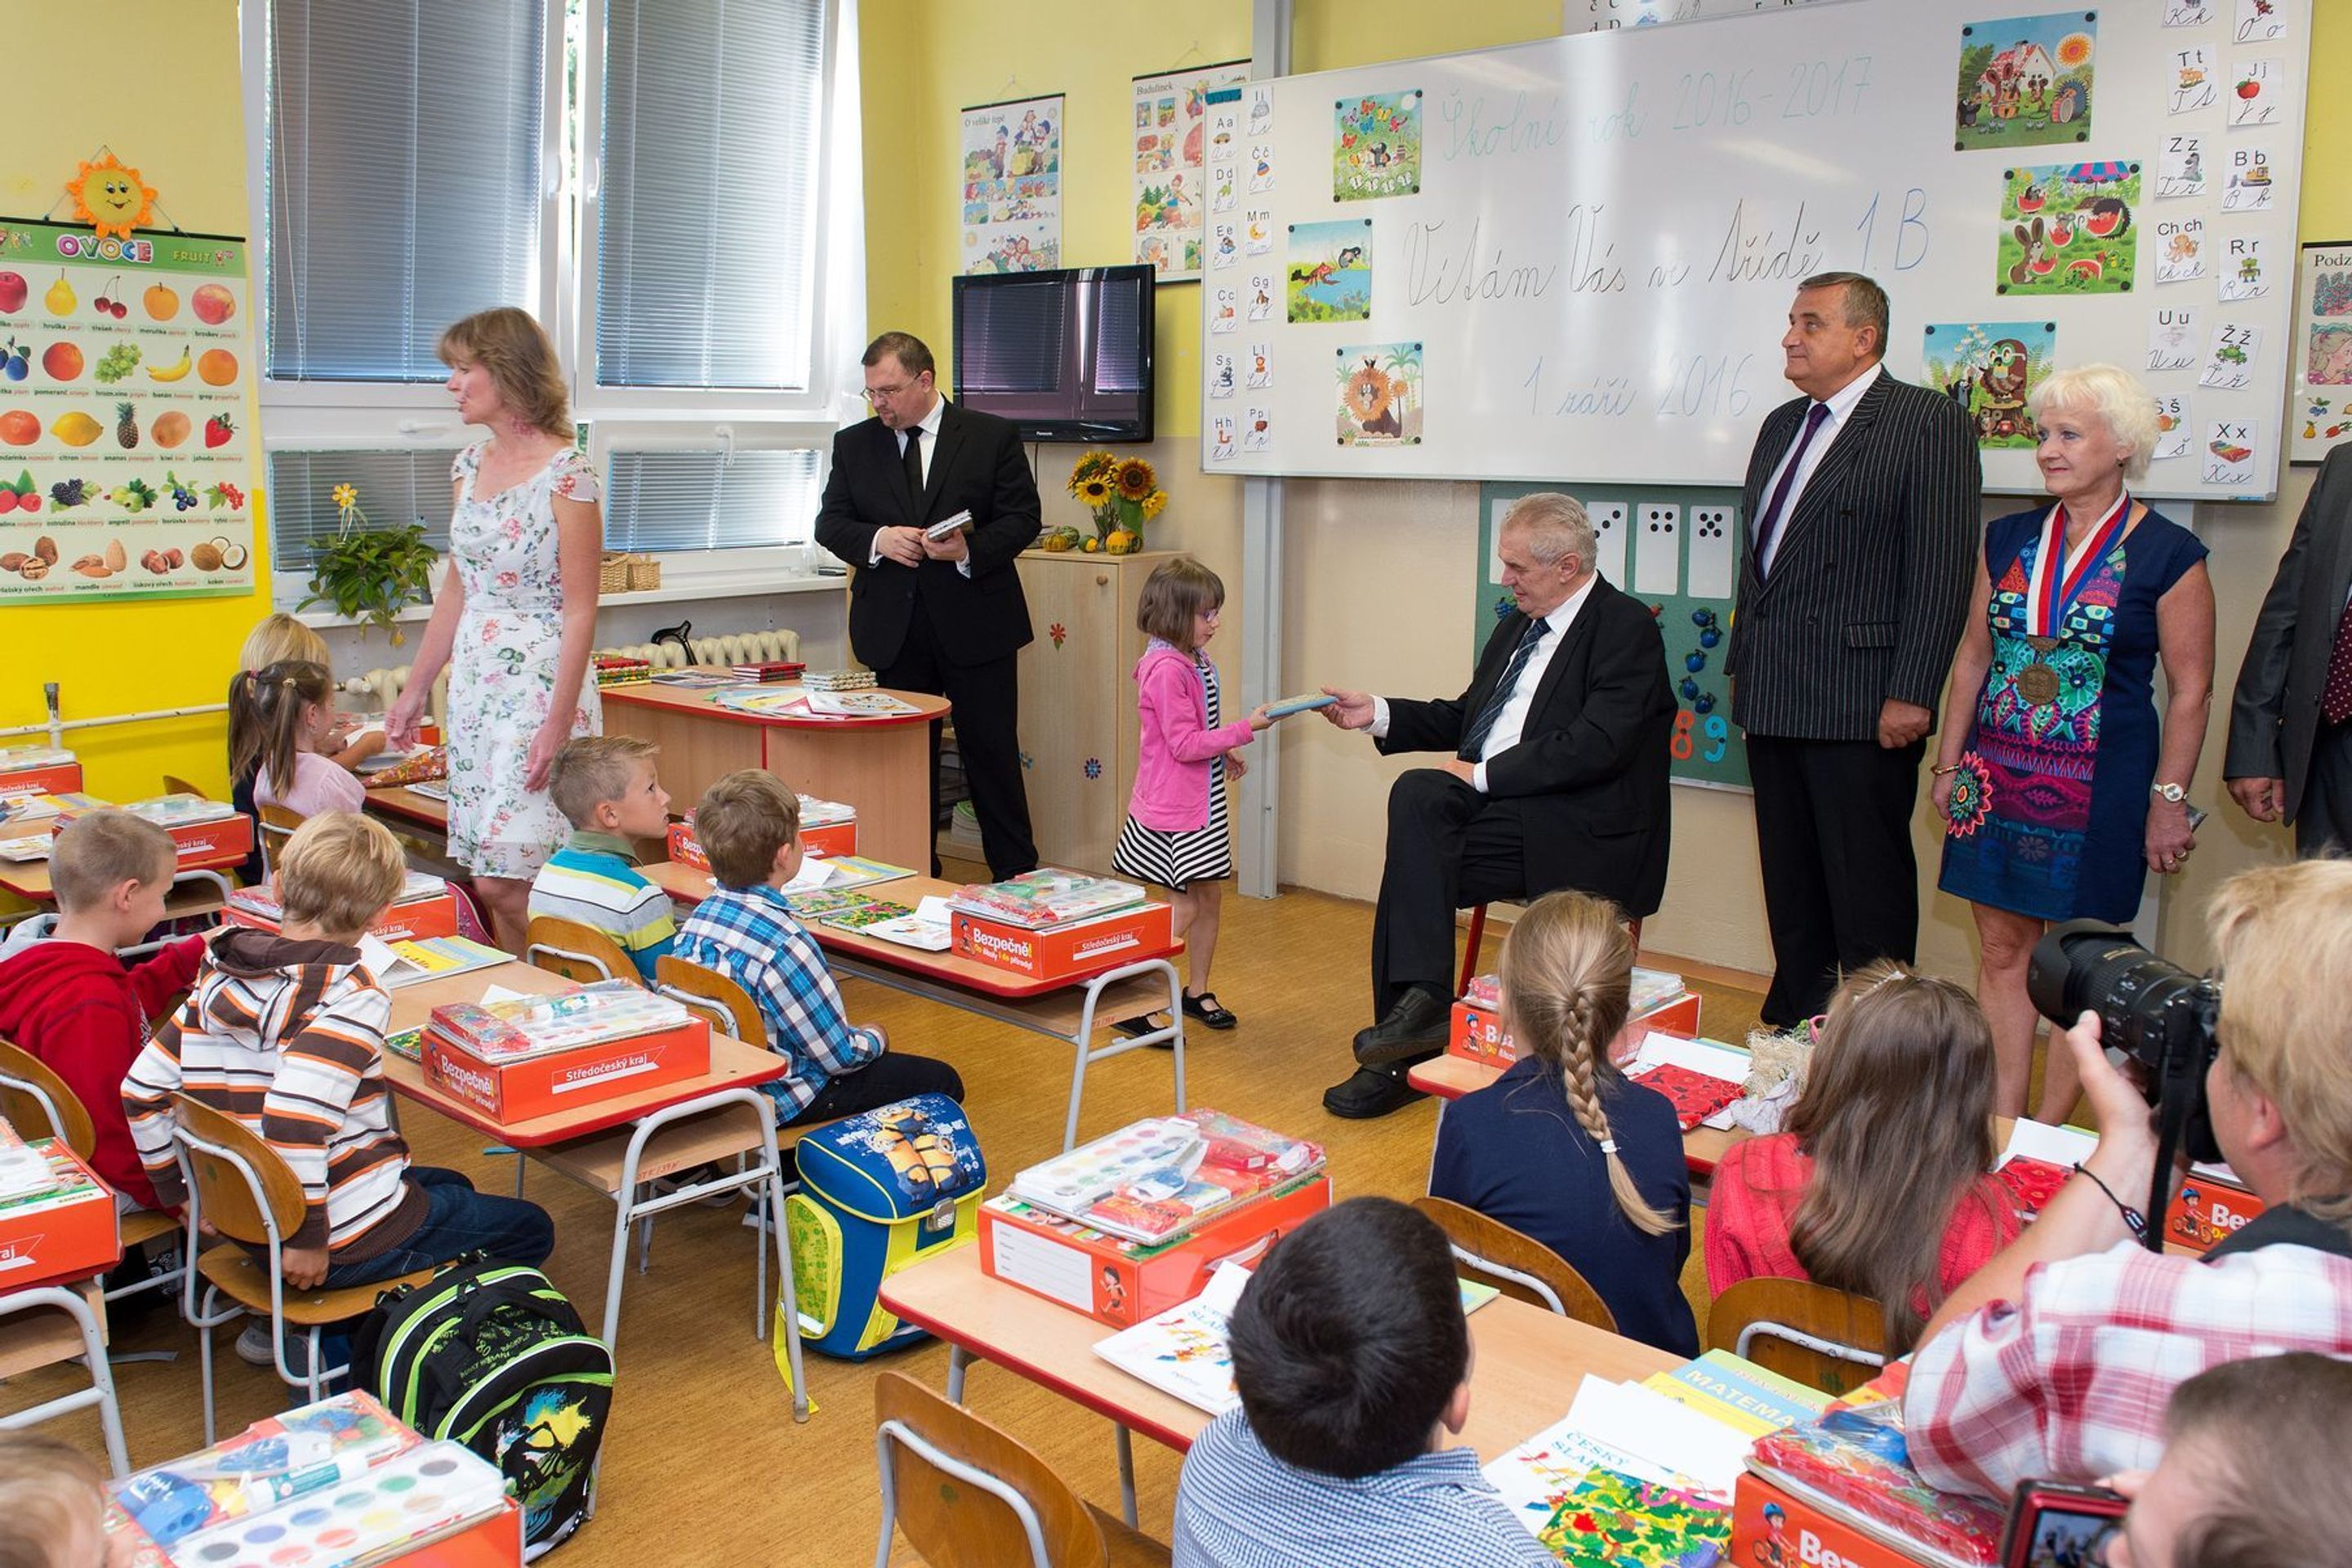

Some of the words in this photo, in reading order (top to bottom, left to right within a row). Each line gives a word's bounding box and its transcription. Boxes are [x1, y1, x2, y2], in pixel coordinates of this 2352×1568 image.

[2158, 222, 2180, 236] Ch
[2185, 219, 2203, 233] ch
[56, 234, 154, 263] OVOCE
[172, 250, 211, 263] FRUIT
[1403, 214, 1558, 306] Vítám
[1568, 203, 1626, 293] Vás
[2314, 253, 2352, 268] Podz
[1656, 353, 1754, 419] 2016
[1704, 715, 1727, 763] 9
[566, 1058, 627, 1082] Středočeský
[629, 1053, 648, 1066] kraj
[1684, 1369, 1796, 1428] MATEMA
